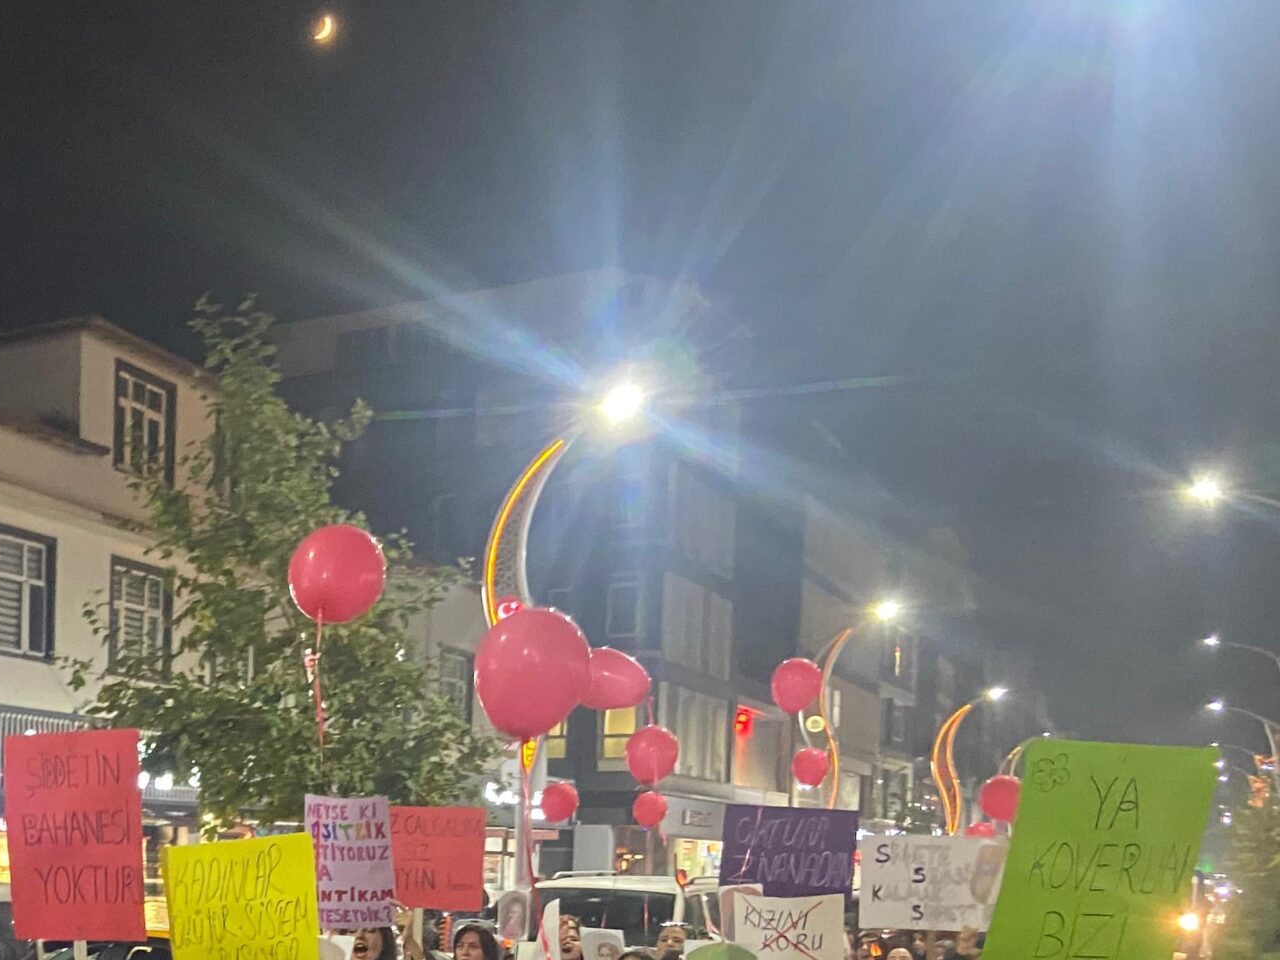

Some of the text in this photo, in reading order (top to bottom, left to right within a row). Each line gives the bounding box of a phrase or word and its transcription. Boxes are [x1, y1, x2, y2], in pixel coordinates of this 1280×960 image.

[307, 803, 349, 821] NEYSE
[1090, 775, 1141, 830] YA
[22, 802, 131, 847] BAHANESİ
[314, 842, 390, 861] TİYORUZ
[34, 865, 141, 905] YOKTUR
[317, 886, 394, 902] NTİKAM
[318, 905, 393, 923] TESEYDİK?
